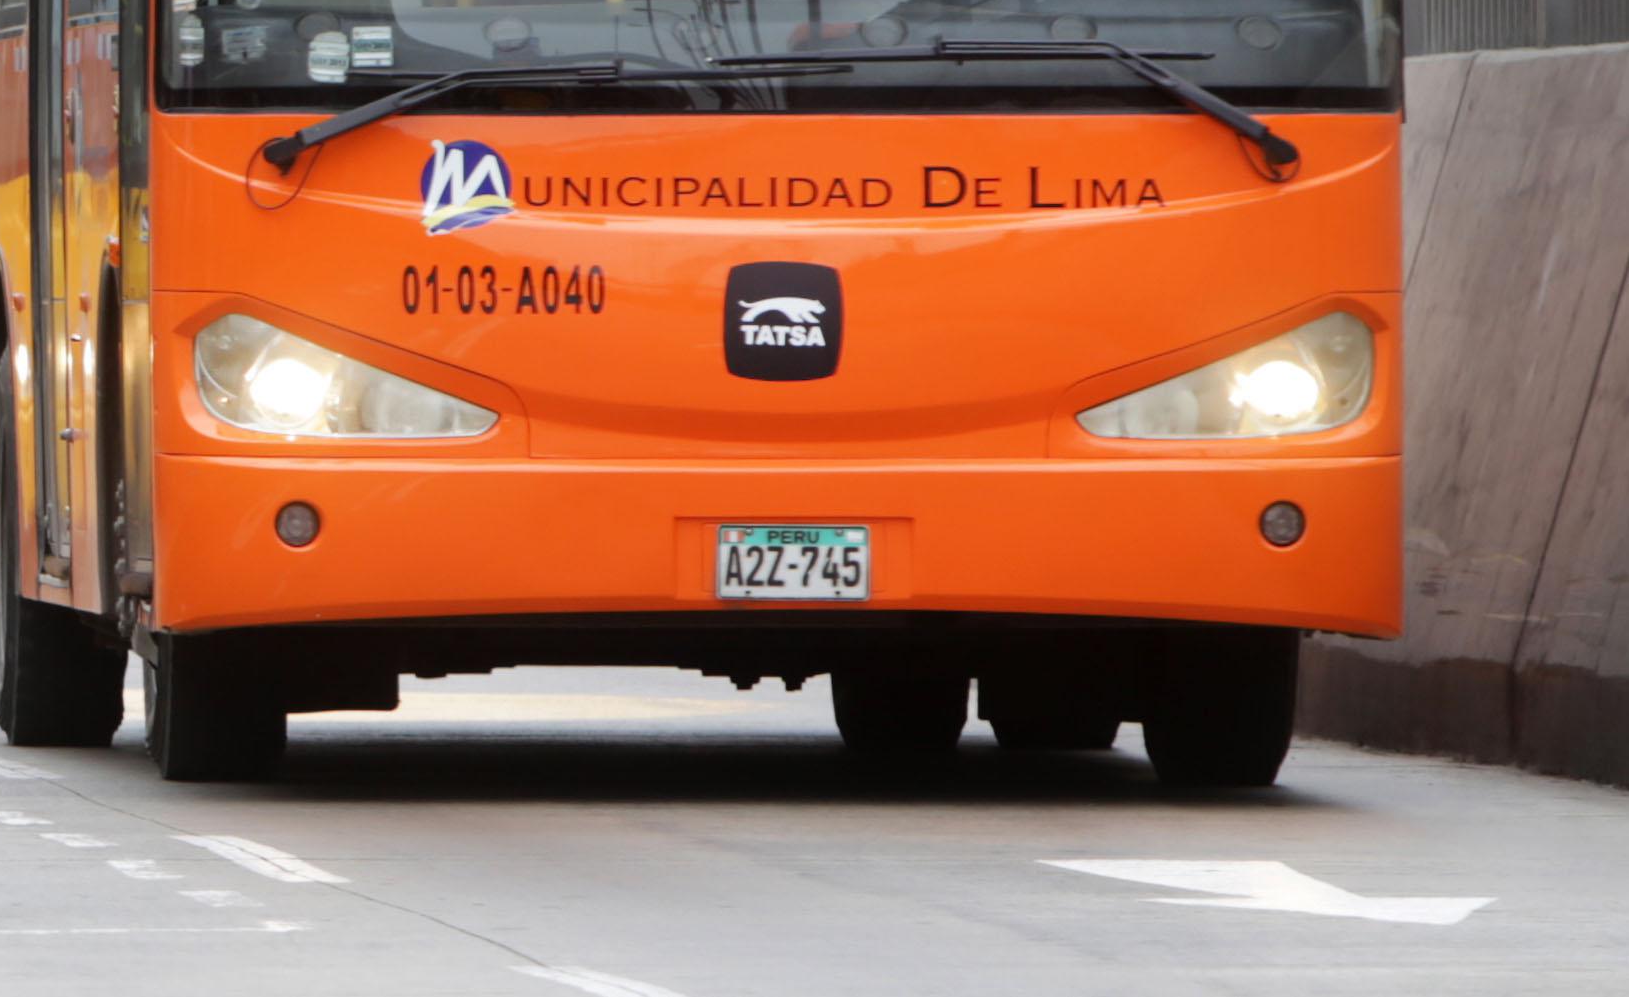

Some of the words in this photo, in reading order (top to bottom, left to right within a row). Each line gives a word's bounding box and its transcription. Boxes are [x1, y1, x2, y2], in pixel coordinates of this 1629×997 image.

[402, 265, 605, 315] 01-03-A040
[740, 324, 826, 347] TATSA
[766, 530, 820, 545] PERU
[724, 545, 861, 588] A2Z-745
